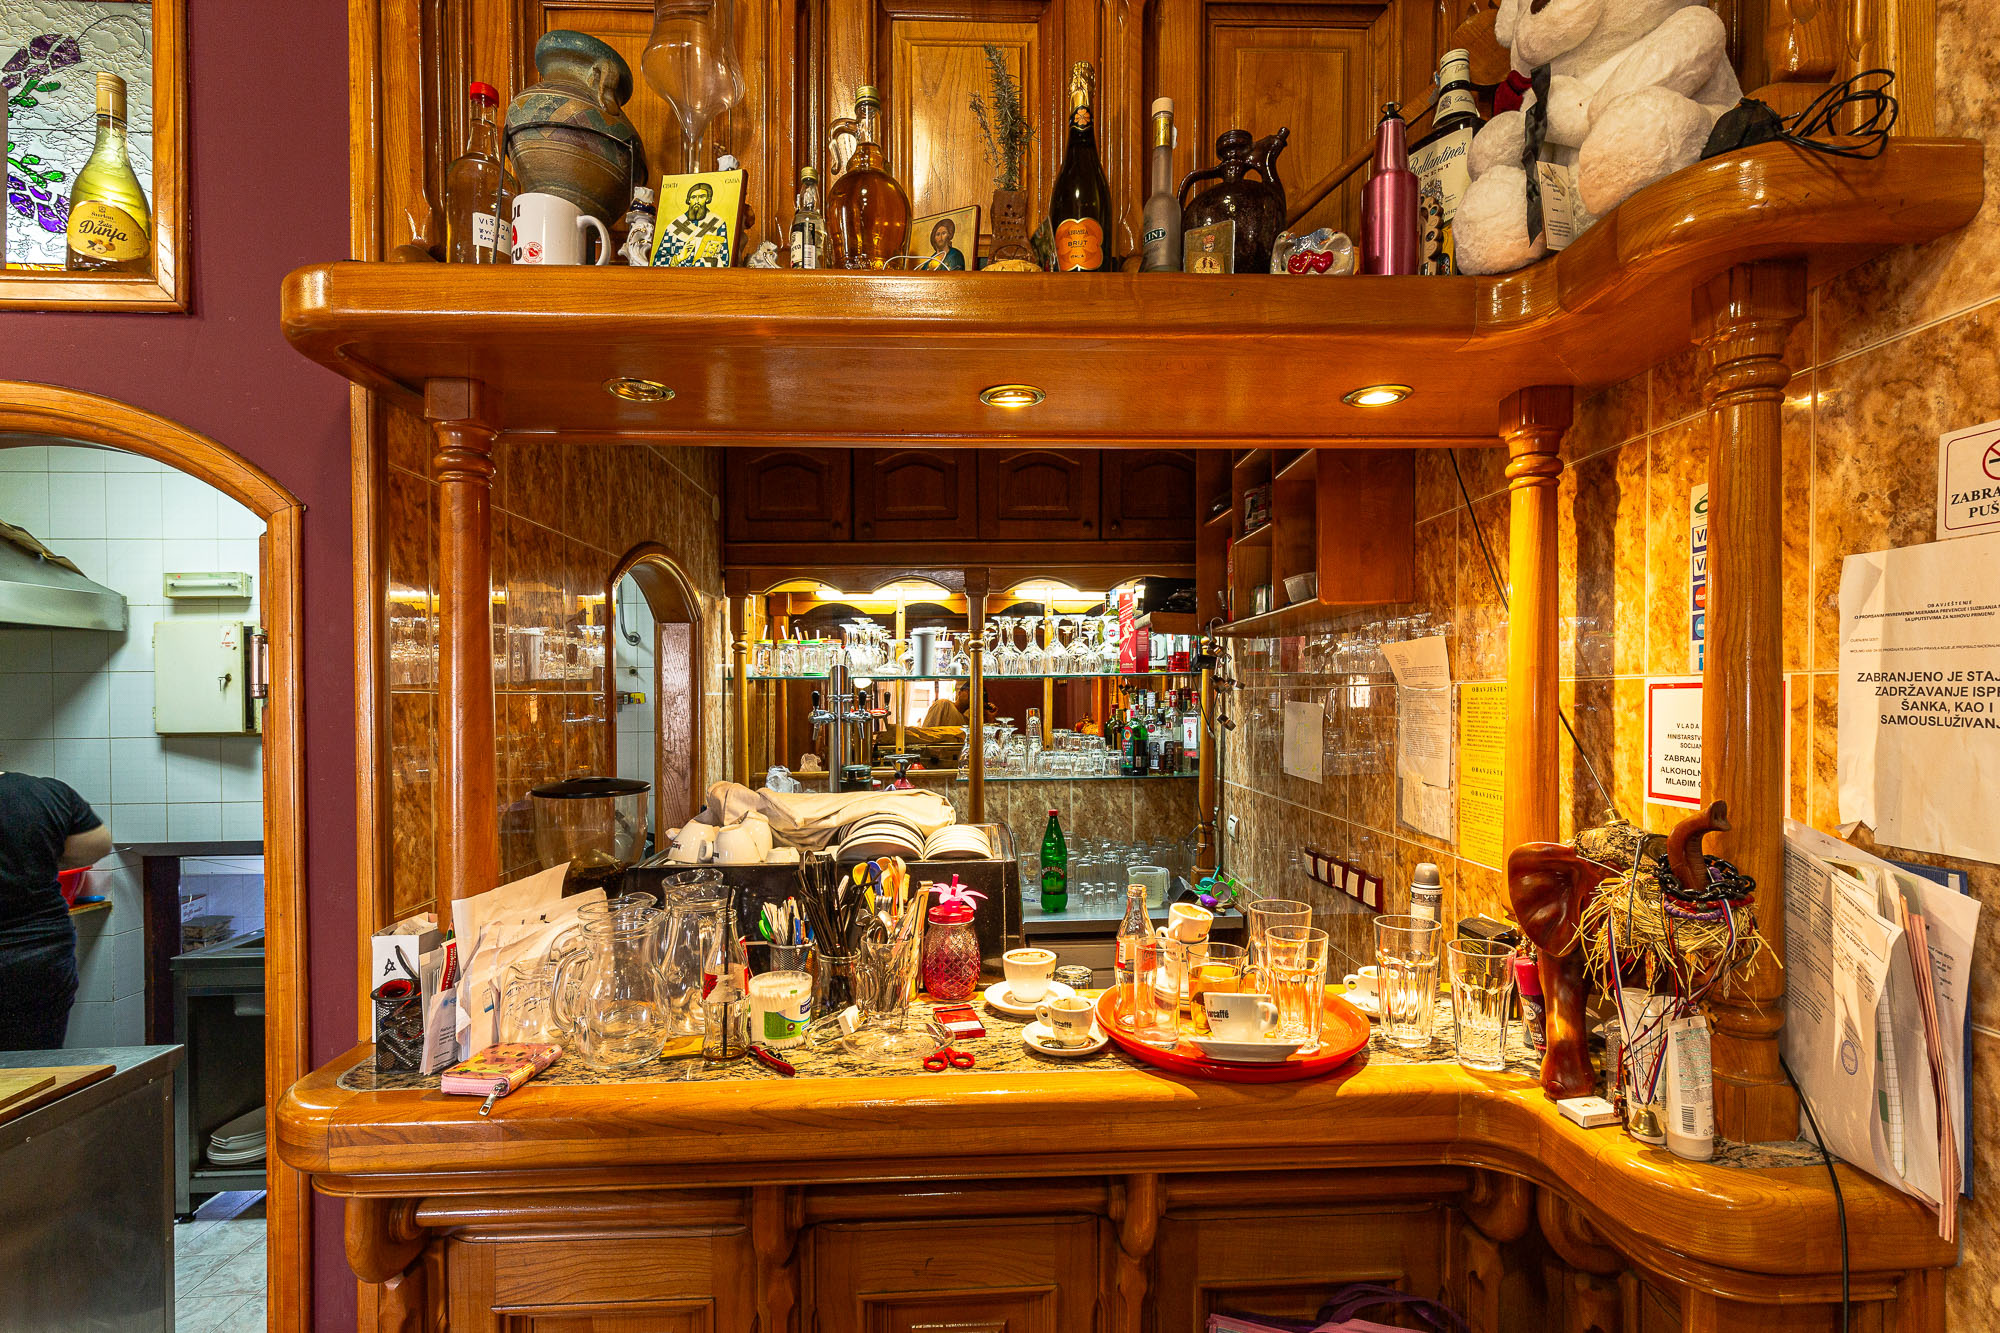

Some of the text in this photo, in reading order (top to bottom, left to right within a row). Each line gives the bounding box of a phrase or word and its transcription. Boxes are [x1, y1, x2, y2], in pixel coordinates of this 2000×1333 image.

[79, 220, 128, 242] Dunja
[1857, 671, 1943, 683] ZABRANJENO
[1947, 671, 1963, 682] JE
[1875, 684, 1969, 697] ZADRŽAVANJE
[1901, 698, 1993, 714] ŠANKA, KAO I
[1664, 754, 1700, 763] ZABRANJ
[1665, 777, 1696, 787] MLAĐIM
